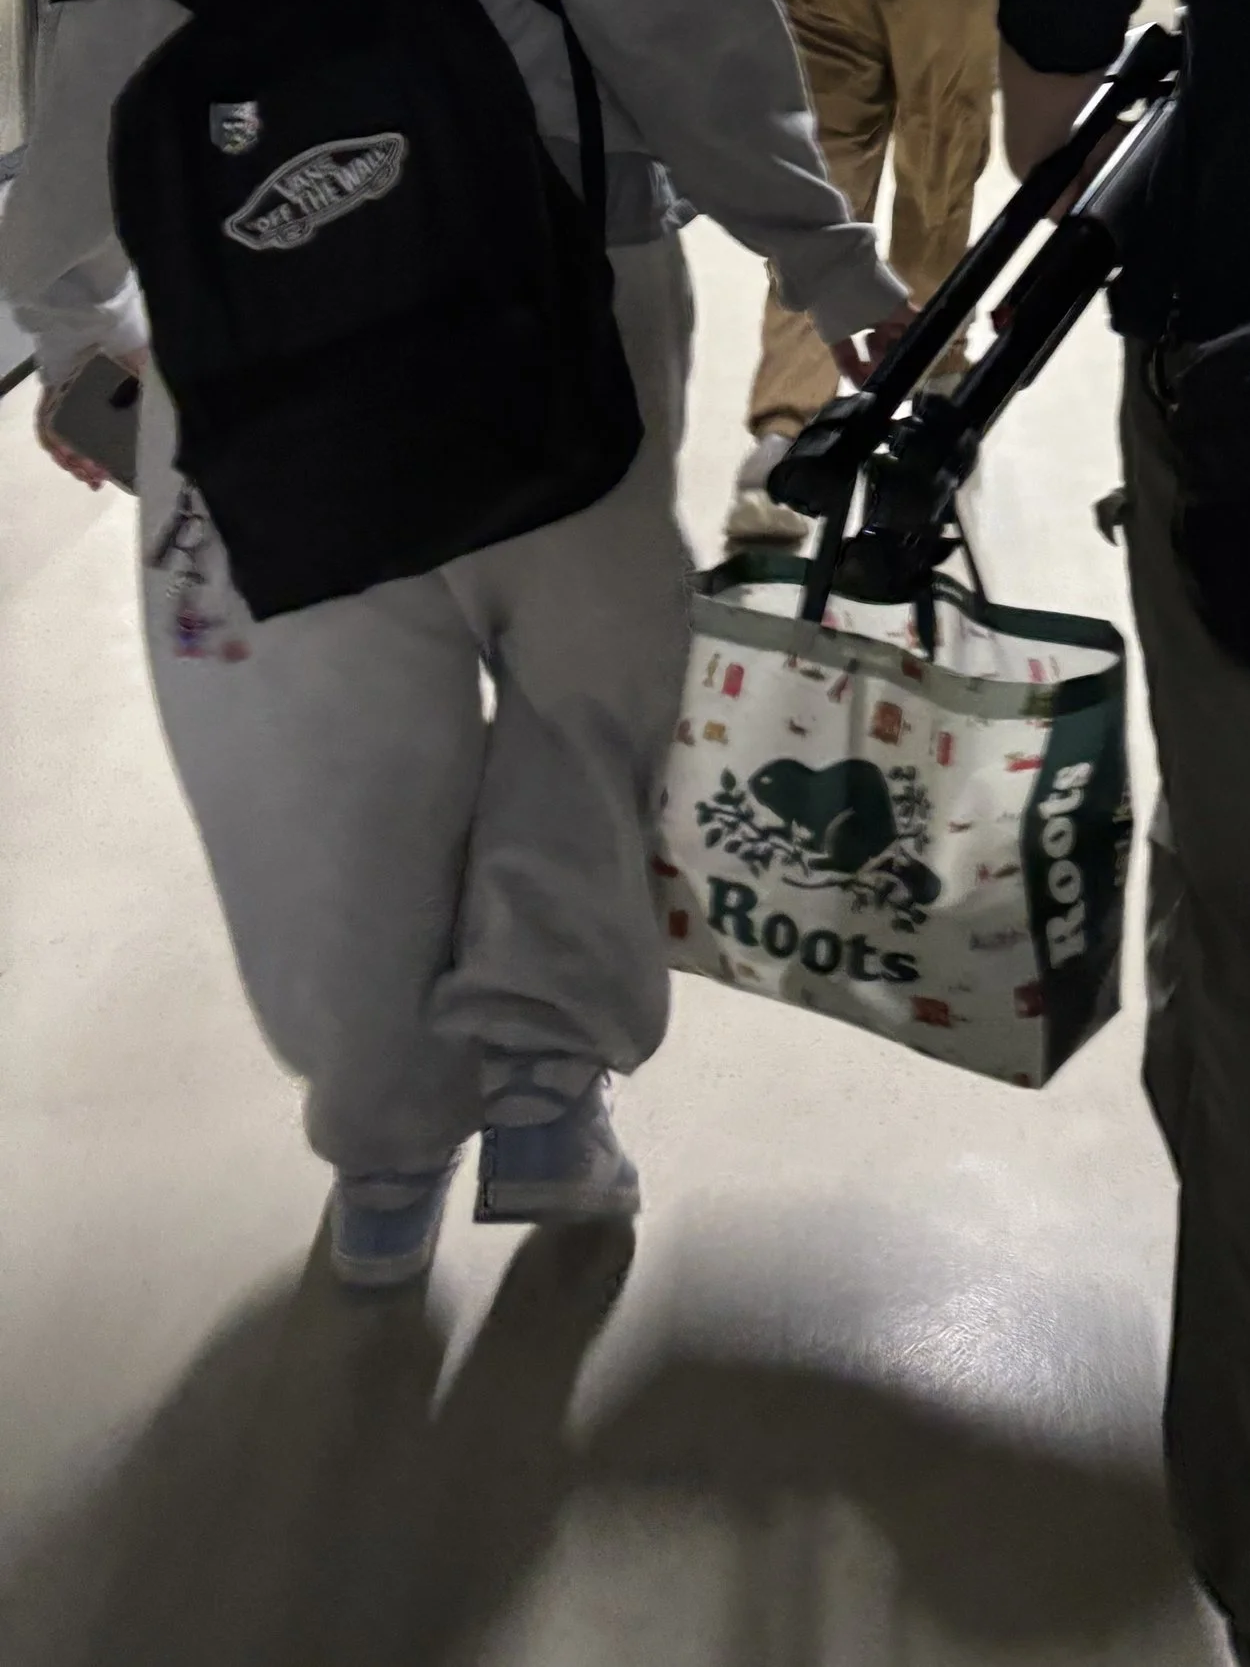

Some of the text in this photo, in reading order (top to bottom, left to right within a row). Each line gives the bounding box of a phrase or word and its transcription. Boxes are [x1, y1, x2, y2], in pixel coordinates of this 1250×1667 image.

[297, 176, 348, 216] THE
[1038, 761, 1094, 969] Roots
[706, 876, 919, 982] Roots
